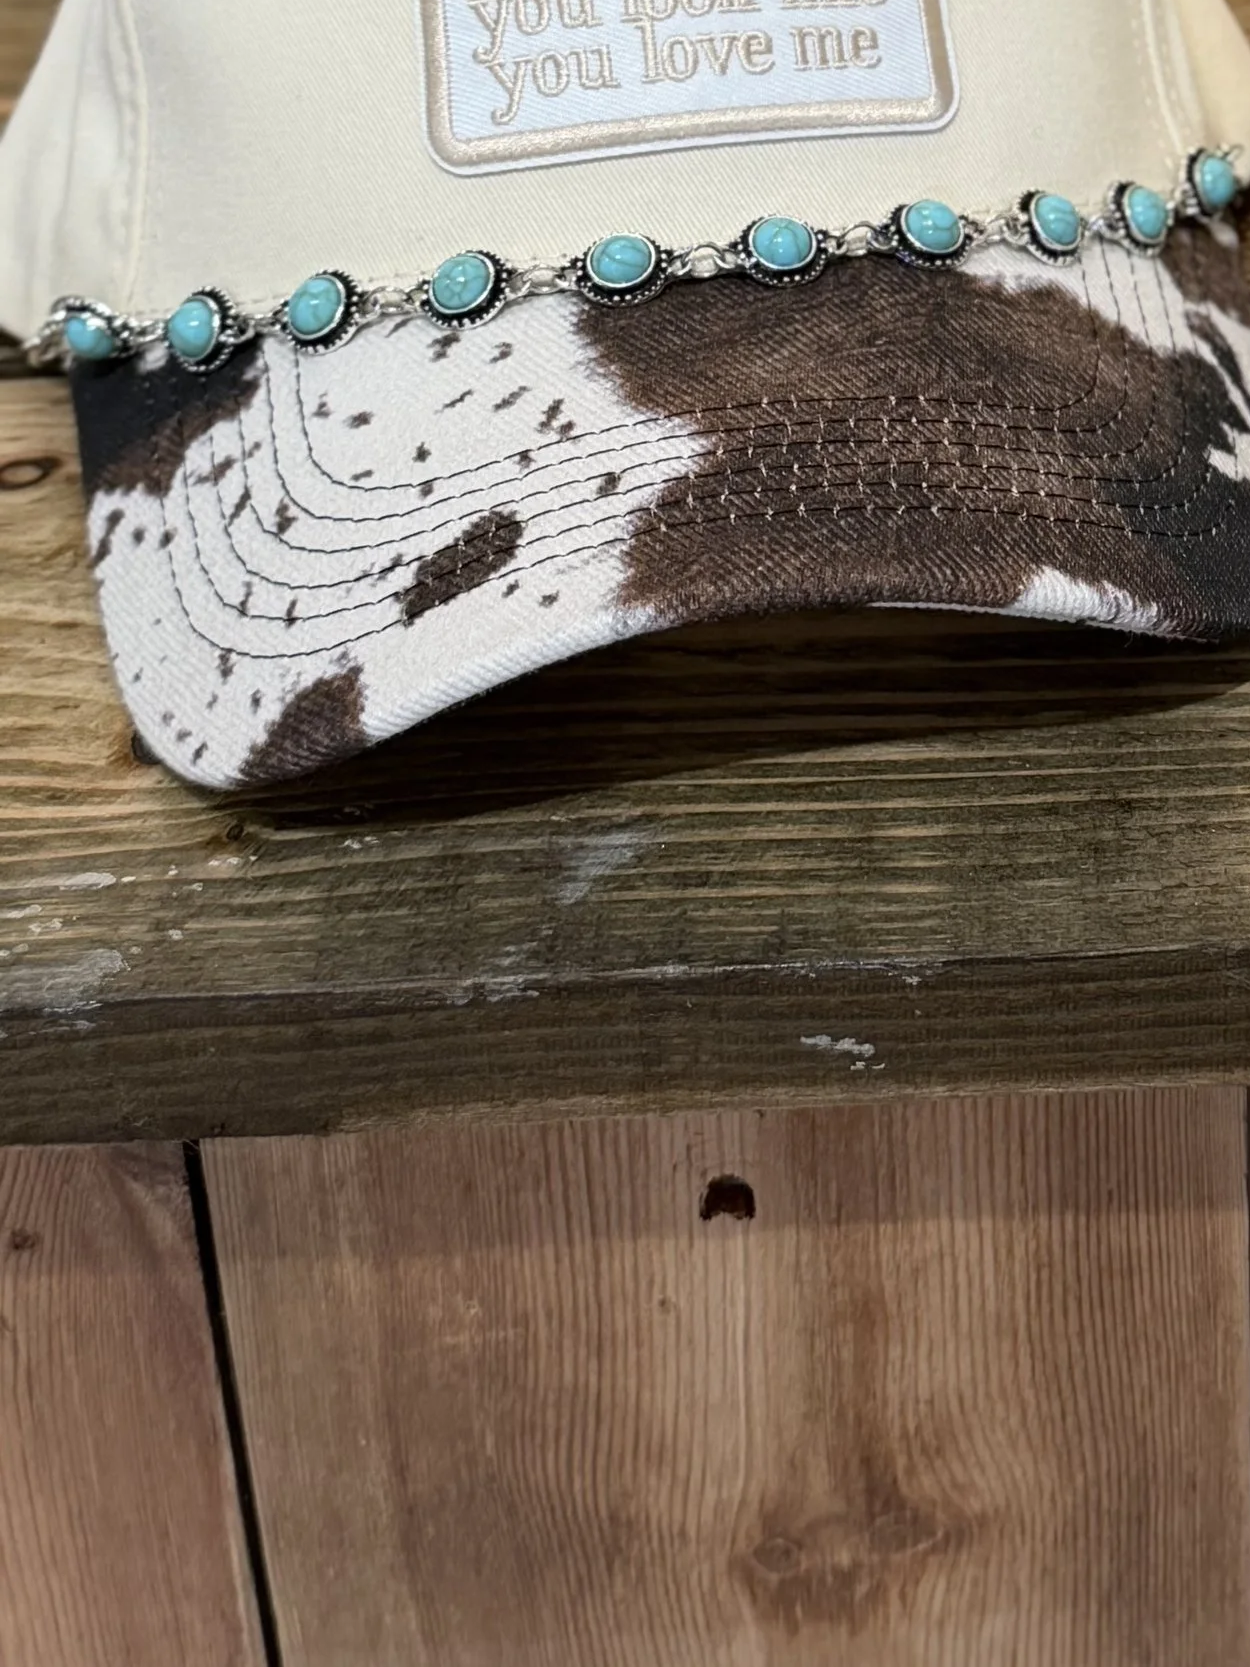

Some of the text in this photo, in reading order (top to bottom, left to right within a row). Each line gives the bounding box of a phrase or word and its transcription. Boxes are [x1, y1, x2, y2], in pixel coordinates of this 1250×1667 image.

[486, 18, 882, 125] you love me
